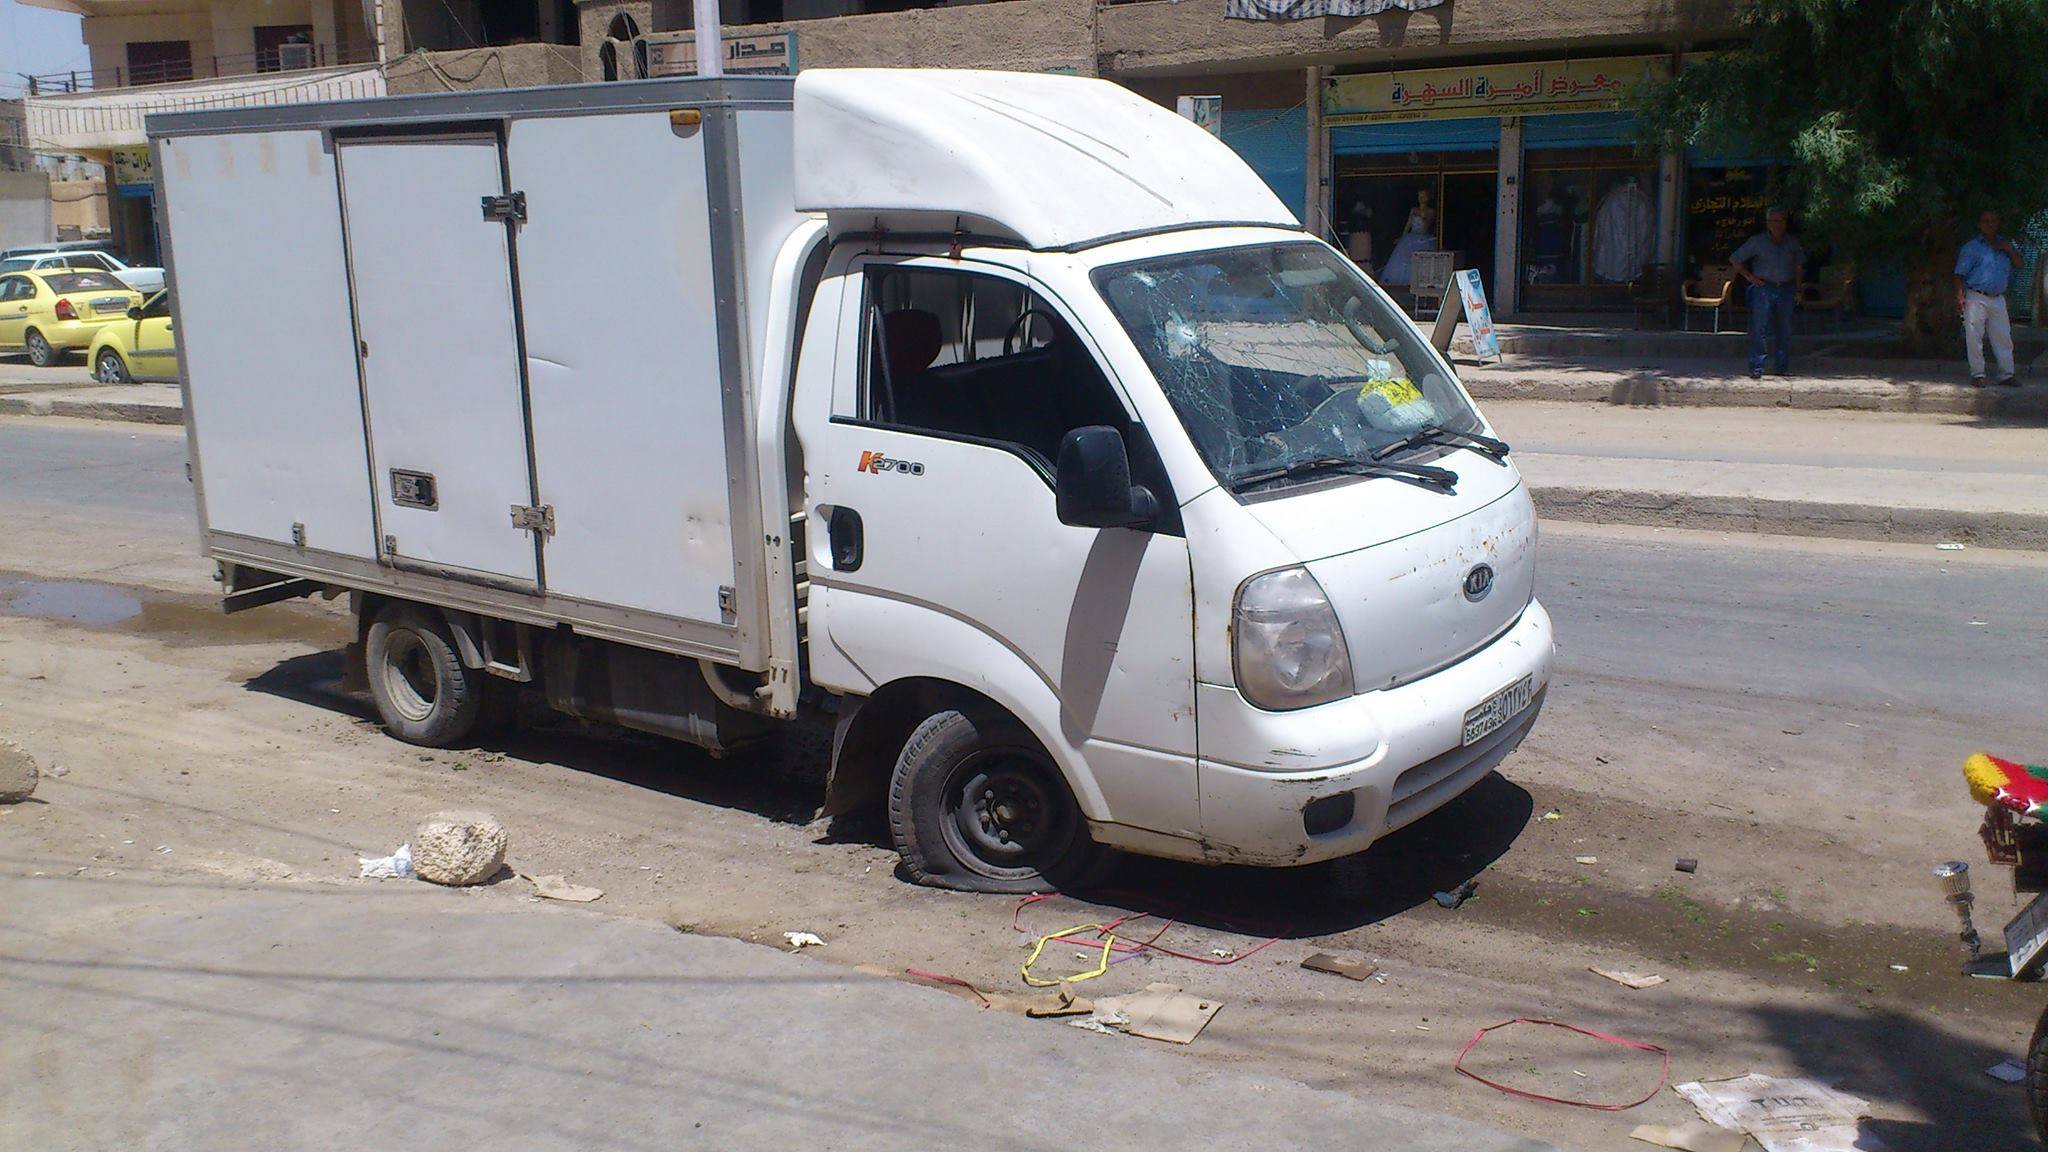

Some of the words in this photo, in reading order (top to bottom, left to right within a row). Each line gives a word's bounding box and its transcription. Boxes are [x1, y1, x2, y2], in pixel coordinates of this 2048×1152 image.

[1391, 77, 1472, 103] السهرة
[1475, 69, 1542, 100] أميرة
[1547, 73, 1621, 97] معرض
[857, 450, 926, 477] K2700
